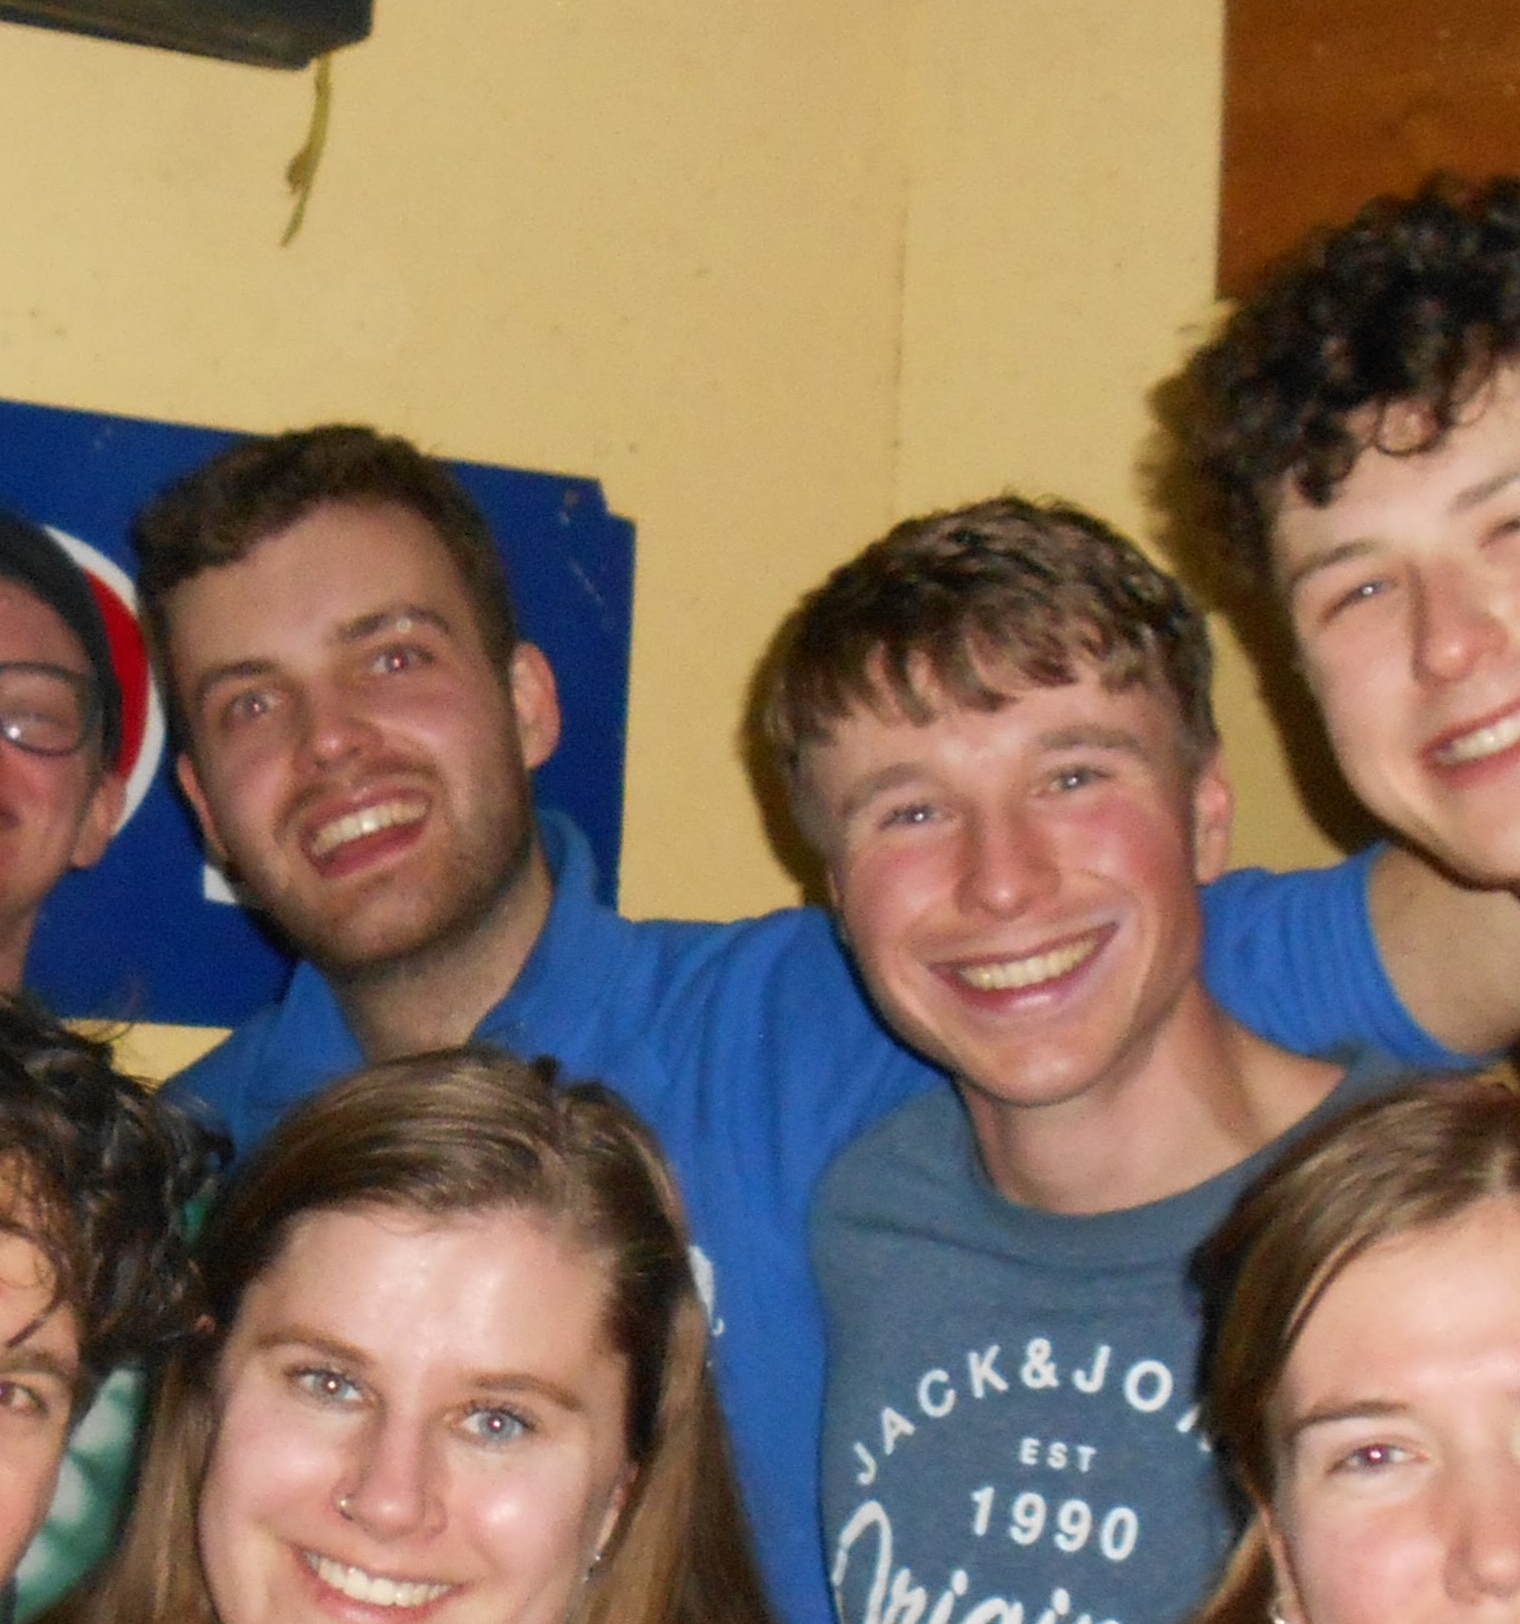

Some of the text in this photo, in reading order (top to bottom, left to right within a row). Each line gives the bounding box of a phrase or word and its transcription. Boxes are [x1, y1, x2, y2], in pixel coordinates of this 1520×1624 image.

[852, 1337, 1212, 1486] JACK&JO
[1019, 1437, 1098, 1473] EST
[970, 1486, 1139, 1561] 1990
